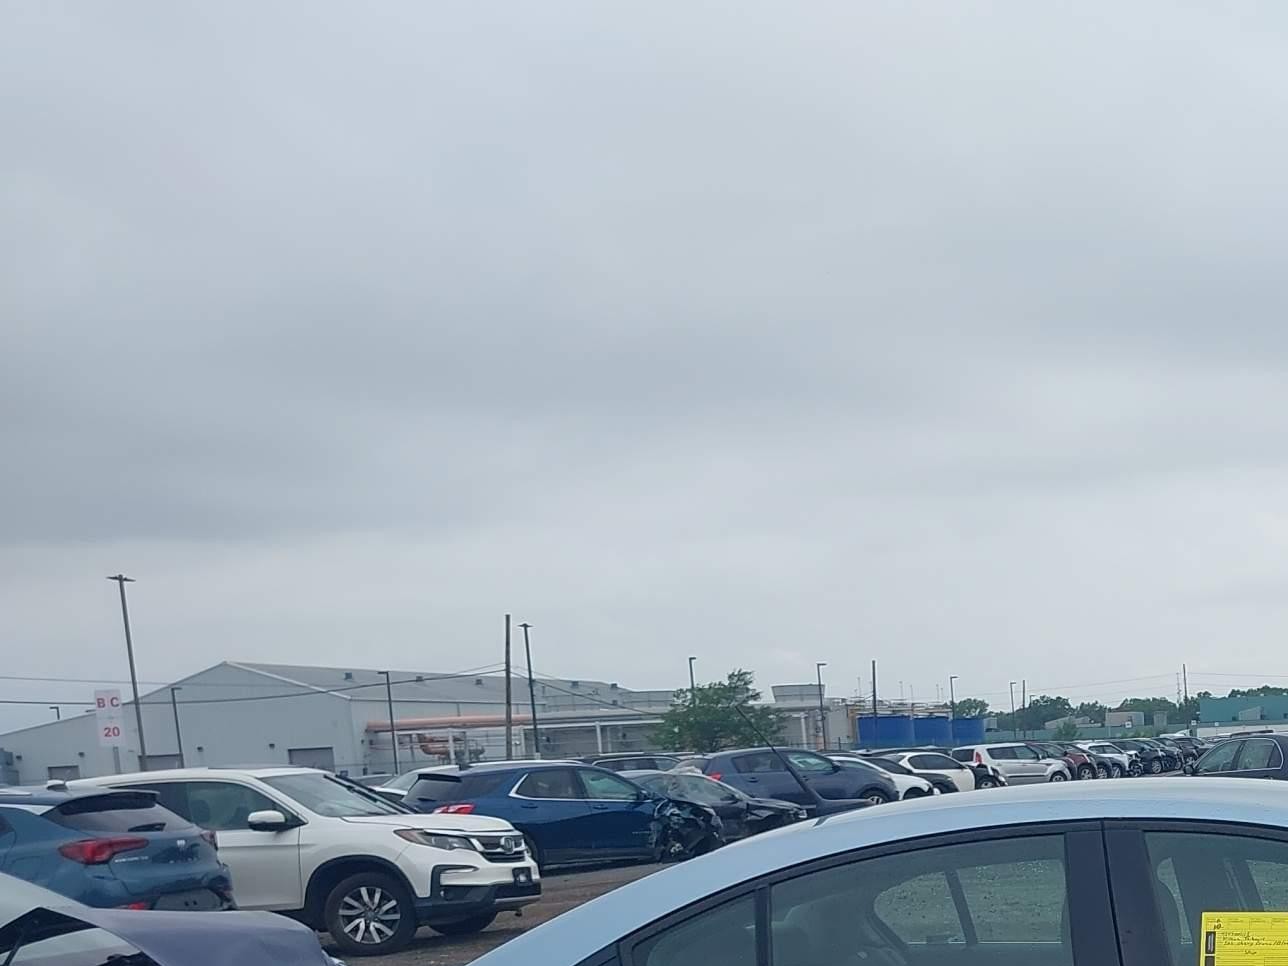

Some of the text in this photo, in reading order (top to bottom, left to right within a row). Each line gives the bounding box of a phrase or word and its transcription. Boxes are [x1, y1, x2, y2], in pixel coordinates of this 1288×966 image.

[96, 696, 120, 709] B C
[103, 726, 121, 738] 20
